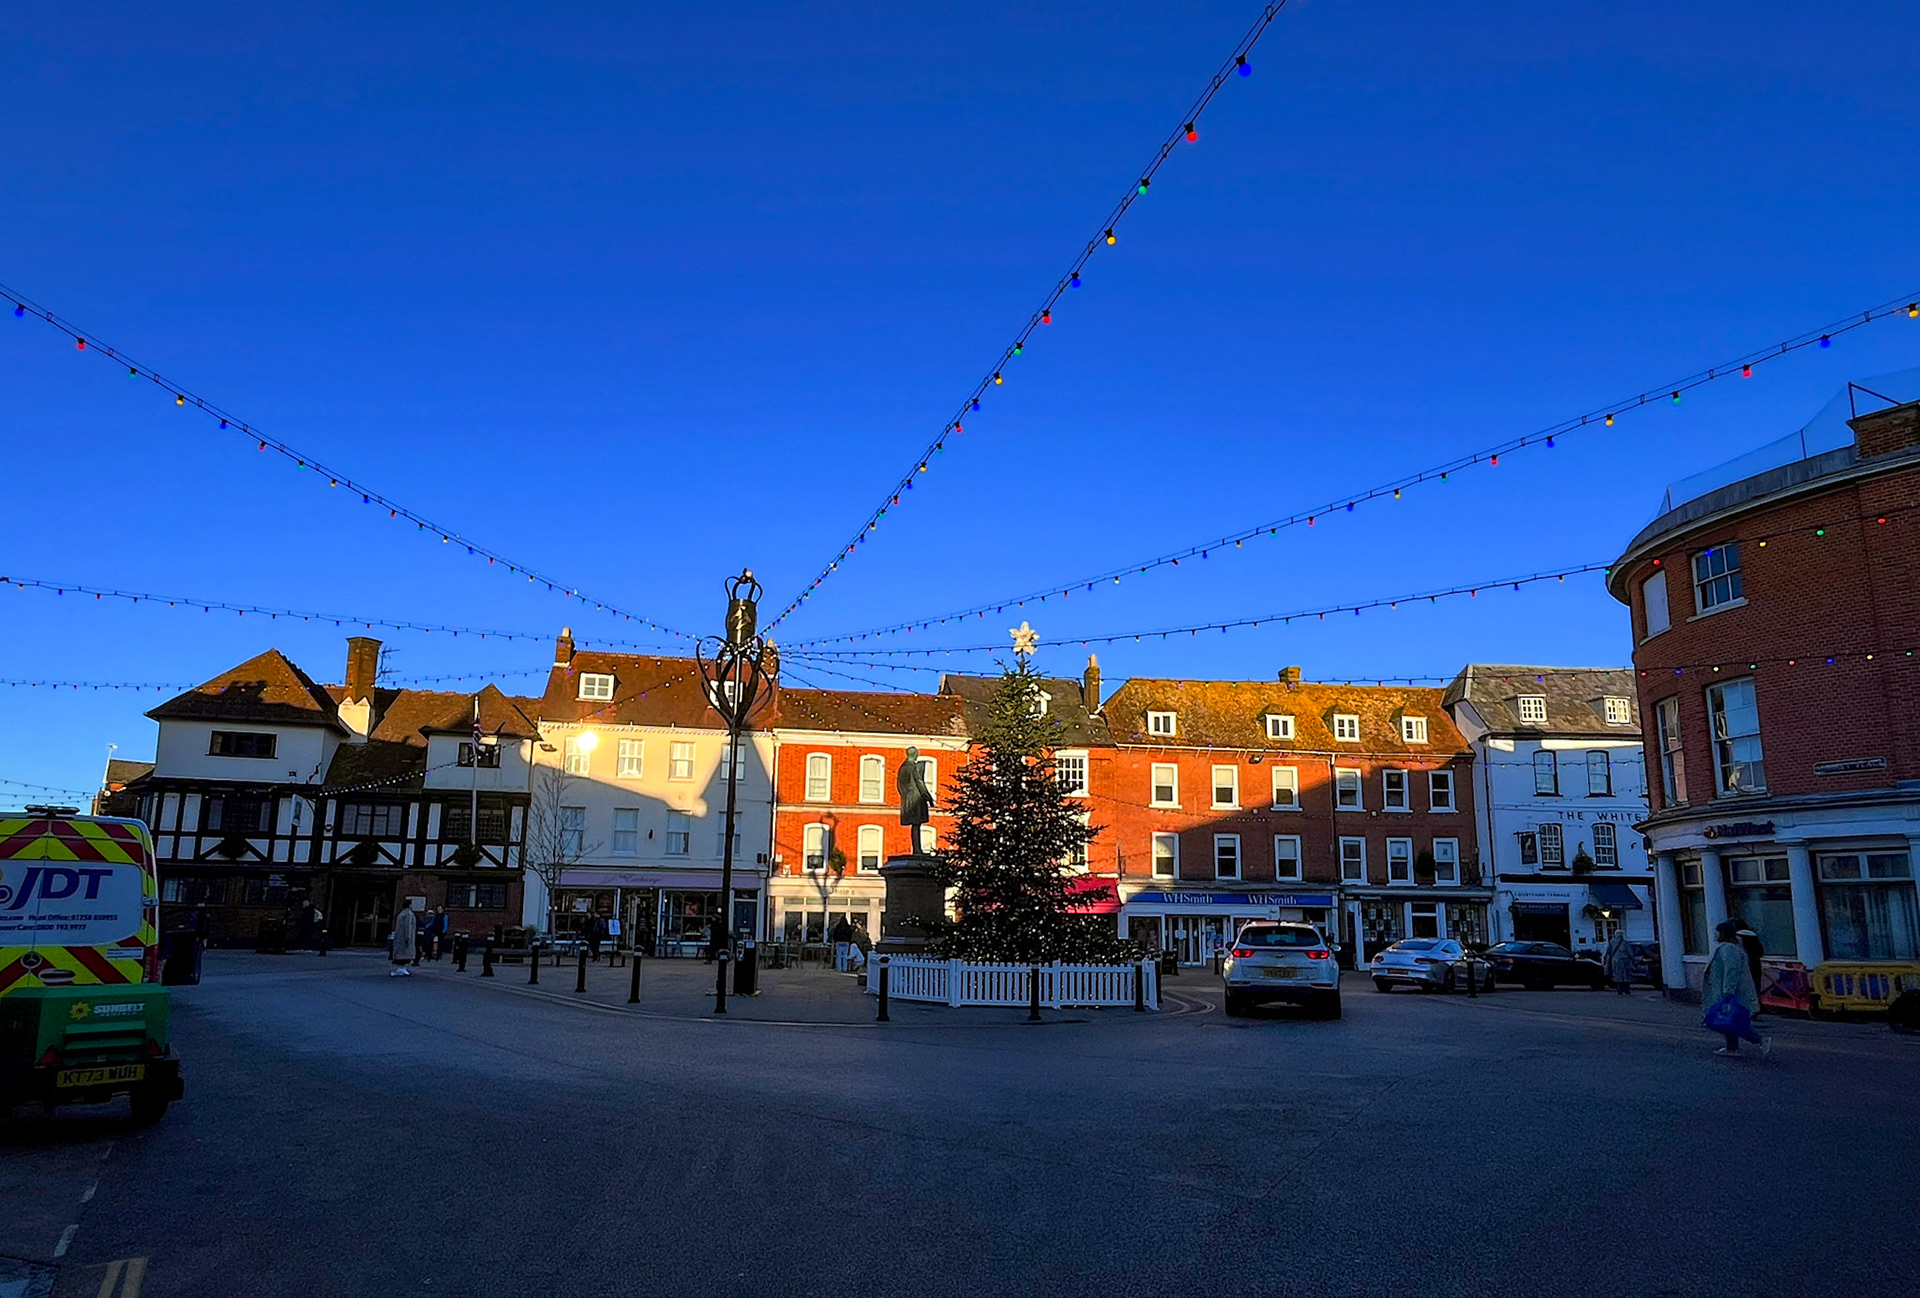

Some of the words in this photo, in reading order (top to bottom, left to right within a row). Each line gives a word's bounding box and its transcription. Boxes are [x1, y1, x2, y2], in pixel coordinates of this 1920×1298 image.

[1558, 811, 1584, 820] THE
[1596, 812, 1642, 822] WHITE
[1716, 820, 1776, 837] NatWest
[5, 867, 113, 911] JDT
[1163, 892, 1213, 904] WHSmith
[1247, 893, 1297, 905] WHSmith
